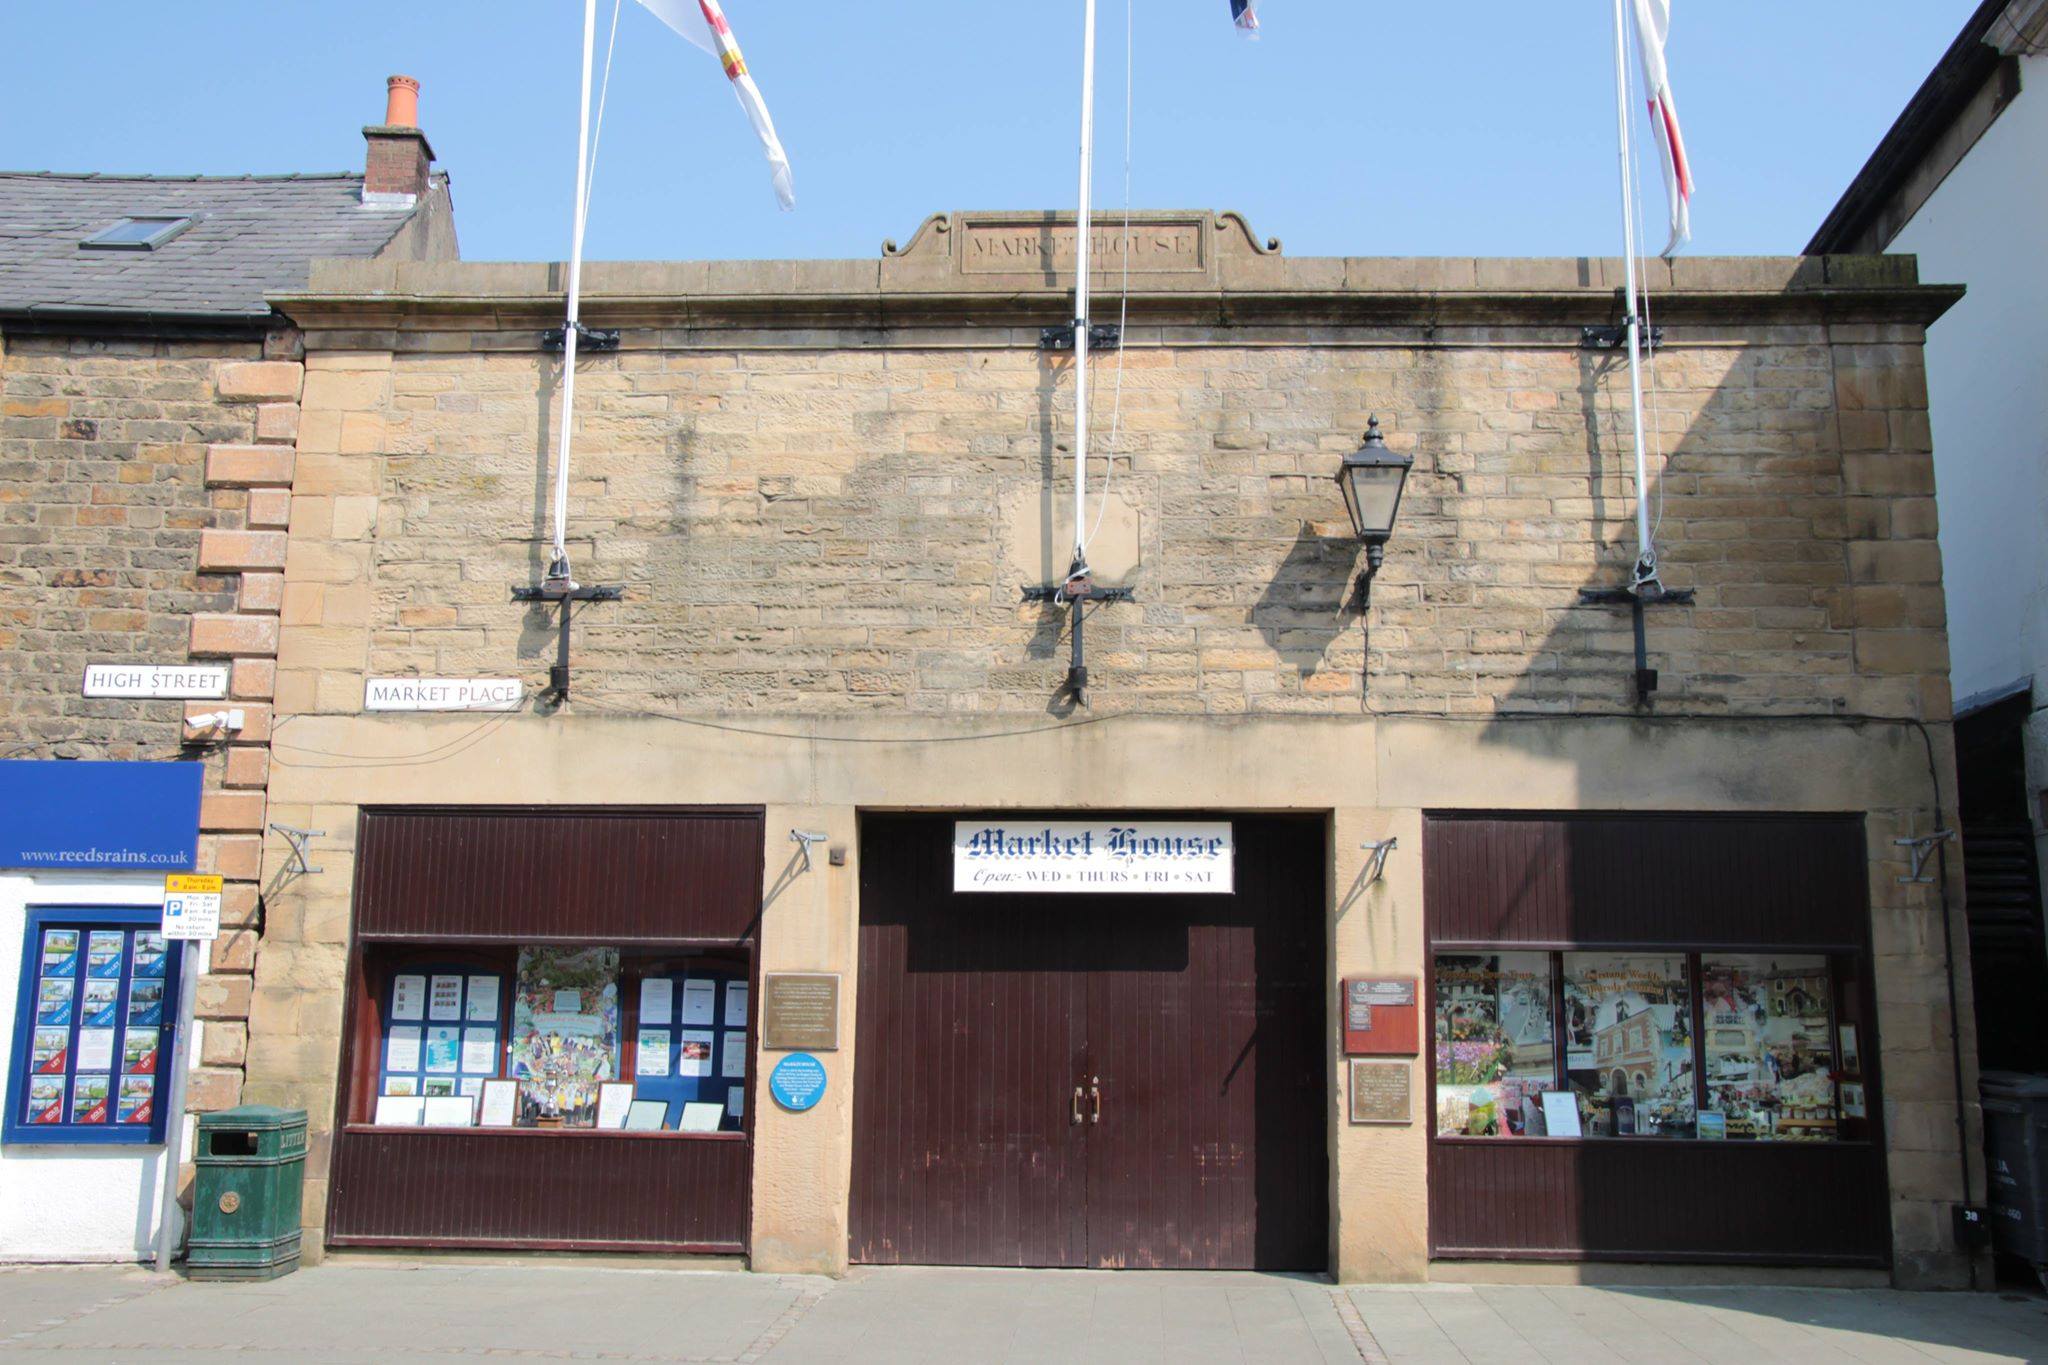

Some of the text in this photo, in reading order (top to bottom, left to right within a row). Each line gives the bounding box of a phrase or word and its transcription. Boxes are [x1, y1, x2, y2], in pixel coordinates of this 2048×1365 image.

[1091, 235, 1193, 256] HOUSE
[92, 673, 221, 689] HIGH STREET
[373, 686, 515, 702] MARKET PLACE
[966, 826, 1224, 865] Market House
[21, 847, 188, 865] www.reedsrains.co.uk
[1026, 869, 1061, 882] WED
[1078, 869, 1129, 882] THURS
[1144, 869, 1170, 882] FRI
[1184, 869, 1214, 882] SAT
[169, 901, 181, 916] P
[44, 1106, 59, 1120] SOLD
[90, 1106, 105, 1120] SOLD
[136, 1105, 151, 1120] SOLD
